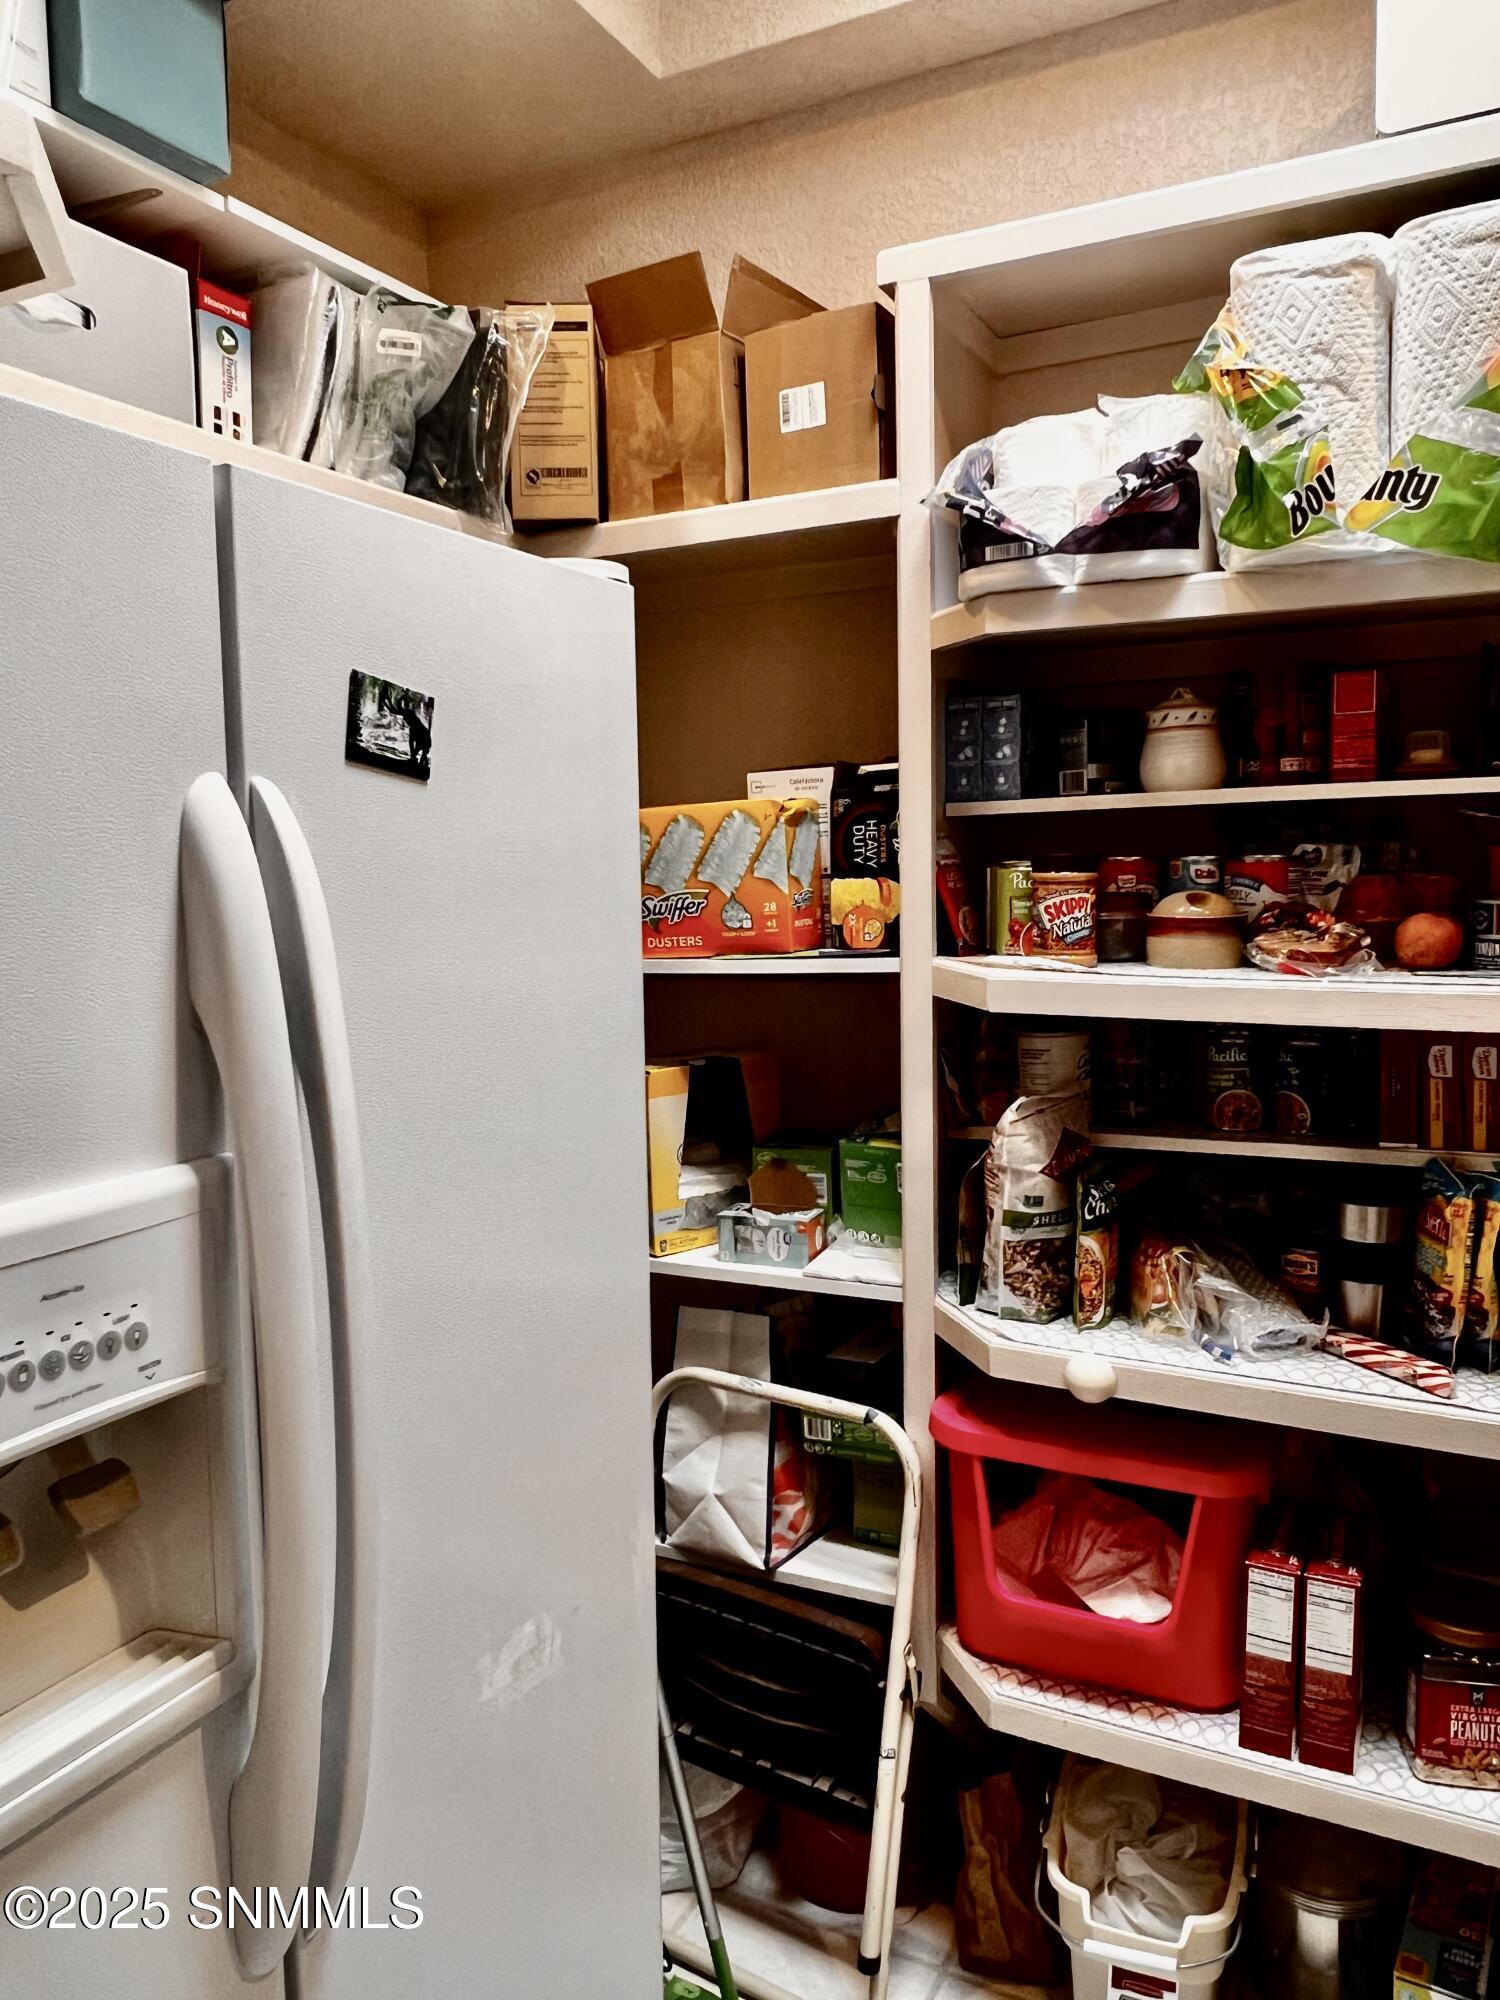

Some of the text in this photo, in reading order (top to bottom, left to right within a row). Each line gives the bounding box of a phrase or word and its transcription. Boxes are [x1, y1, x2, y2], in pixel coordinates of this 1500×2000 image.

[203, 295, 247, 321] Honeywell
[853, 825, 865, 865] DUTY
[866, 820, 878, 868] HEAVY
[1194, 868, 1216, 879] Dole
[642, 895, 705, 924] Swiffer
[763, 902, 777, 912] 28
[1043, 896, 1090, 924] SKIPPY
[647, 936, 703, 948] DUSTERS
[1208, 1046, 1248, 1062] Pacific
[1450, 1704, 1475, 1713] EXTRA
